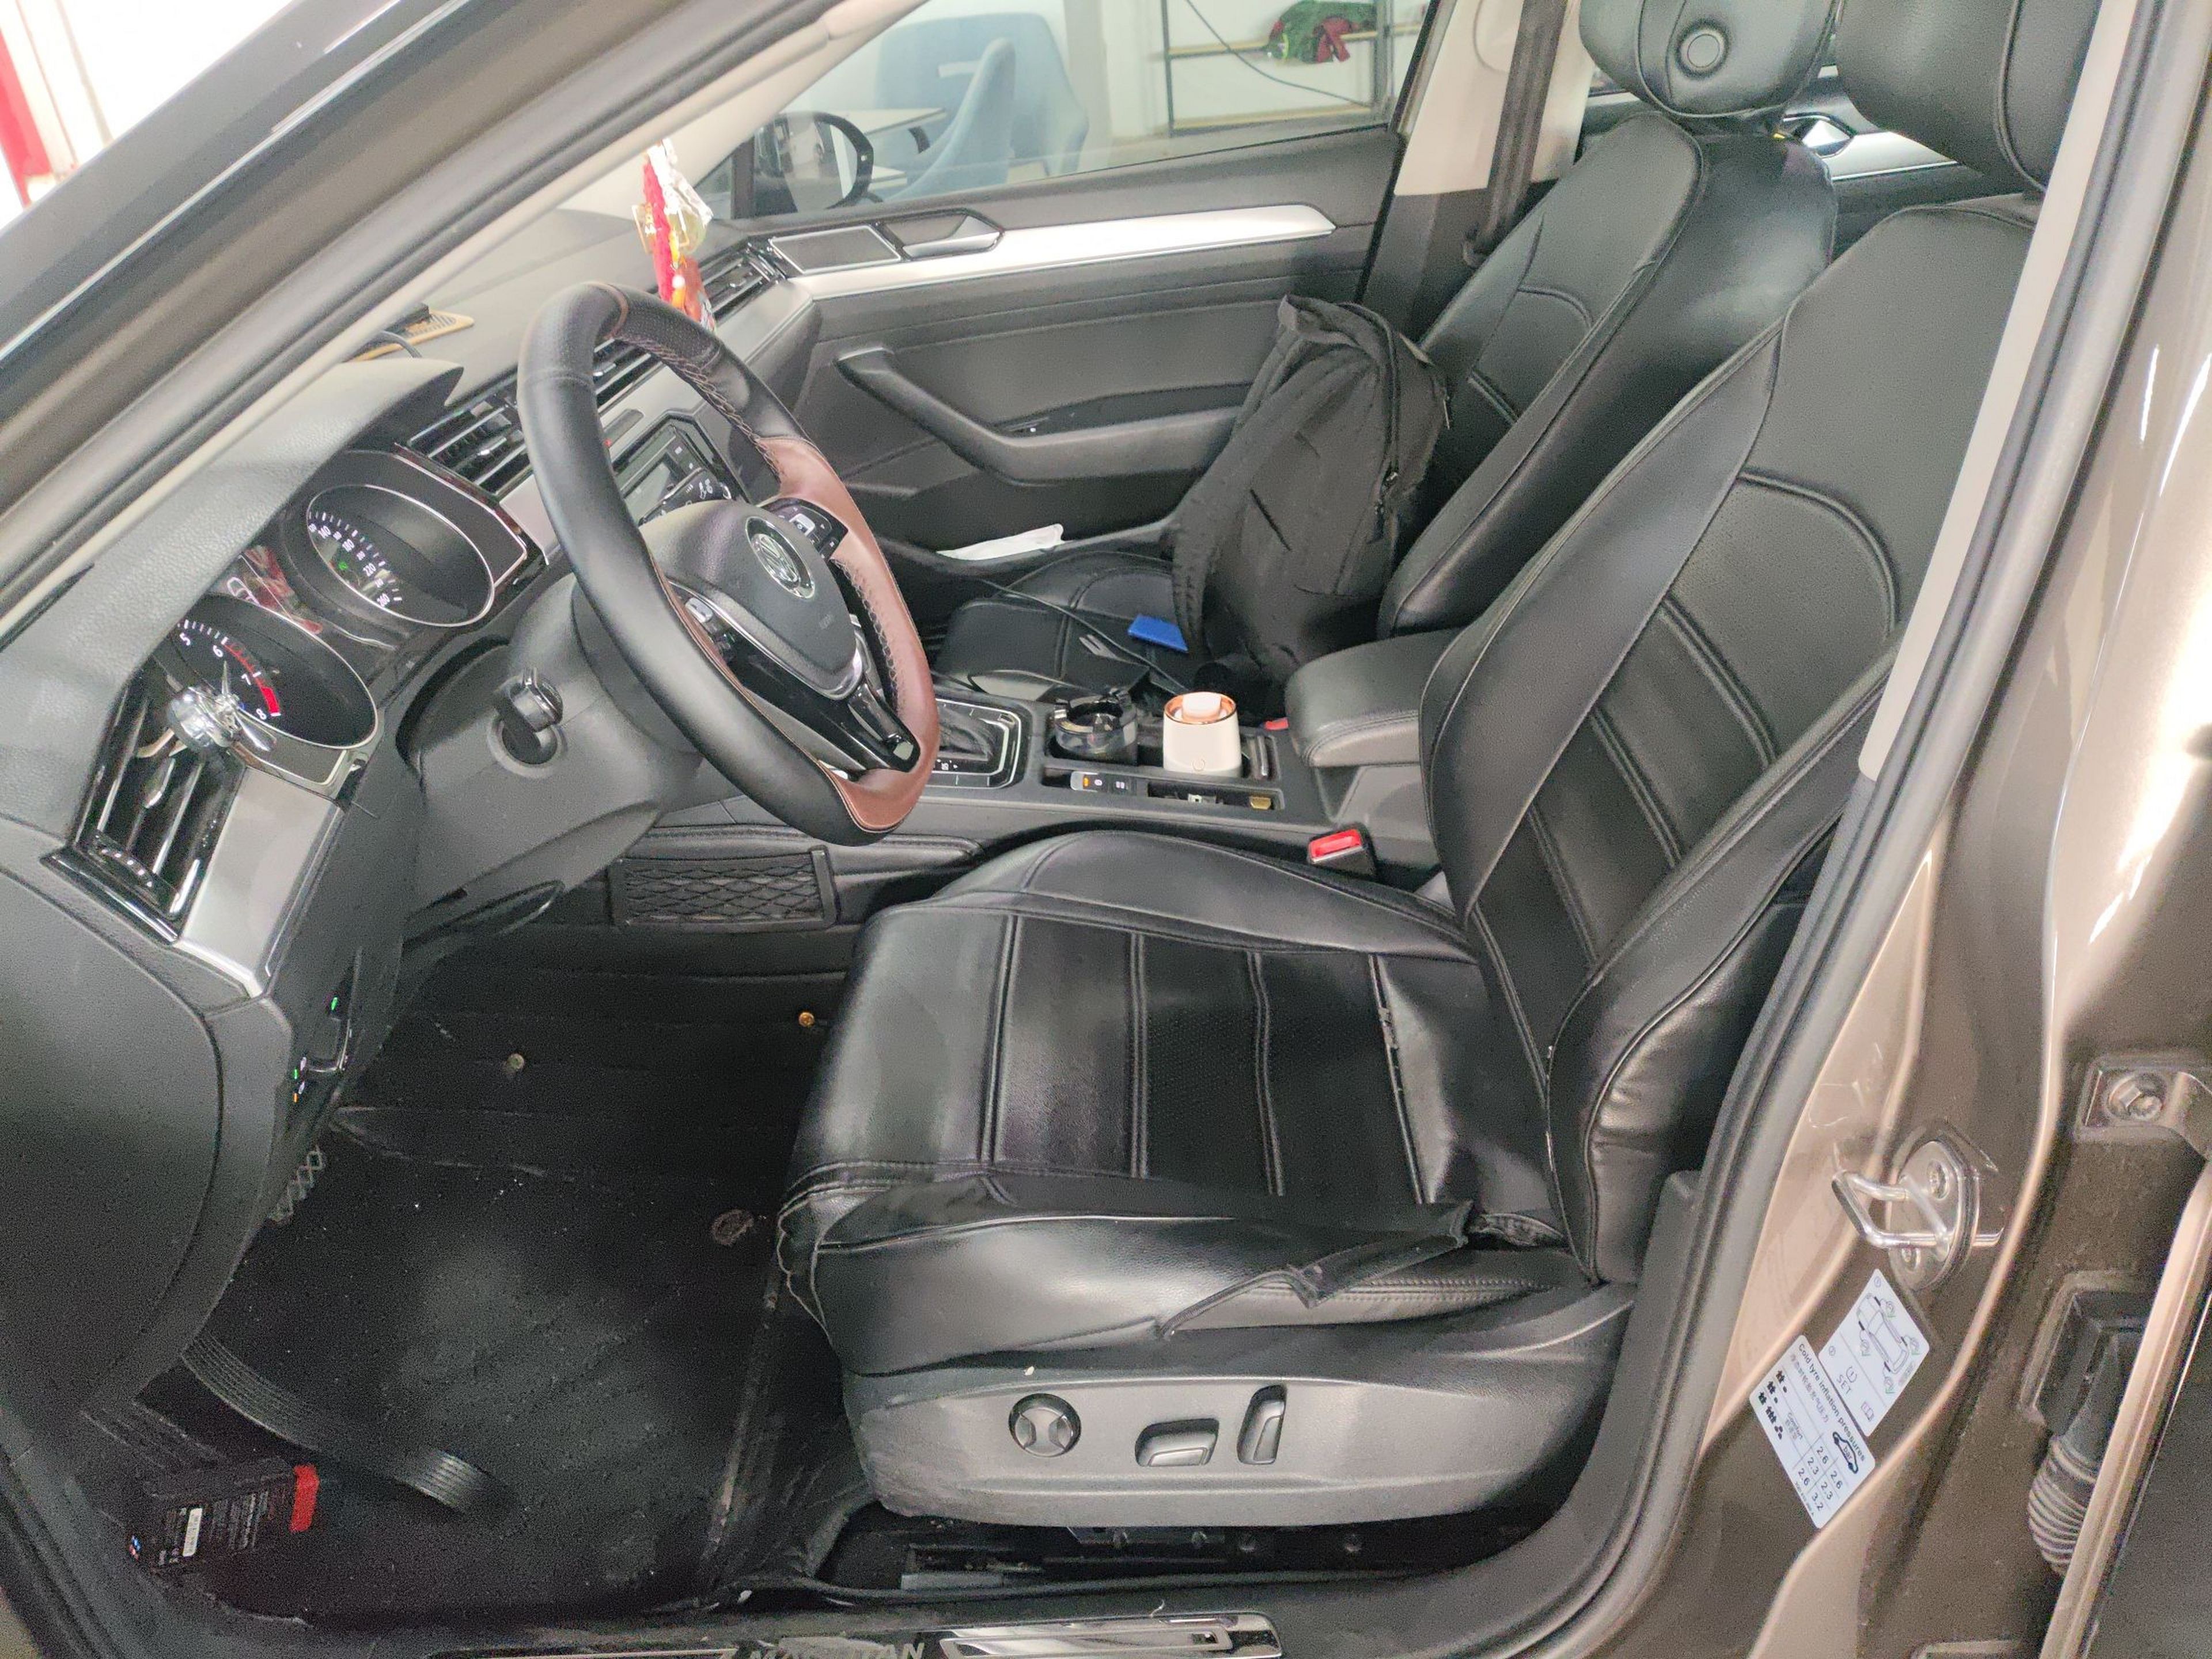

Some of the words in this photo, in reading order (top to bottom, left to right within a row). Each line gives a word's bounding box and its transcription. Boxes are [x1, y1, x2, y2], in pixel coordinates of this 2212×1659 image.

[179, 632, 191, 646] 5
[213, 645, 224, 658] 6
[241, 673, 251, 685] 7
[256, 708, 267, 720] 8
[1836, 1374, 1852, 1395] SET
[1798, 1343, 1810, 1363] Cold
[1809, 1363, 1820, 1381] tyre
[1819, 1380, 1839, 1417] inflation
[1838, 1418, 1865, 1461] pressures
[1843, 1446, 1853, 1459] bar
[1816, 1446, 1829, 1464] 2.6
[1831, 1471, 1843, 1489] 2.6
[1808, 1457, 1819, 1475] 2.3
[1821, 1482, 1833, 1500] 2.3
[1798, 1468, 1810, 1486] 2.6
[1811, 1493, 1824, 1511] 3.2
